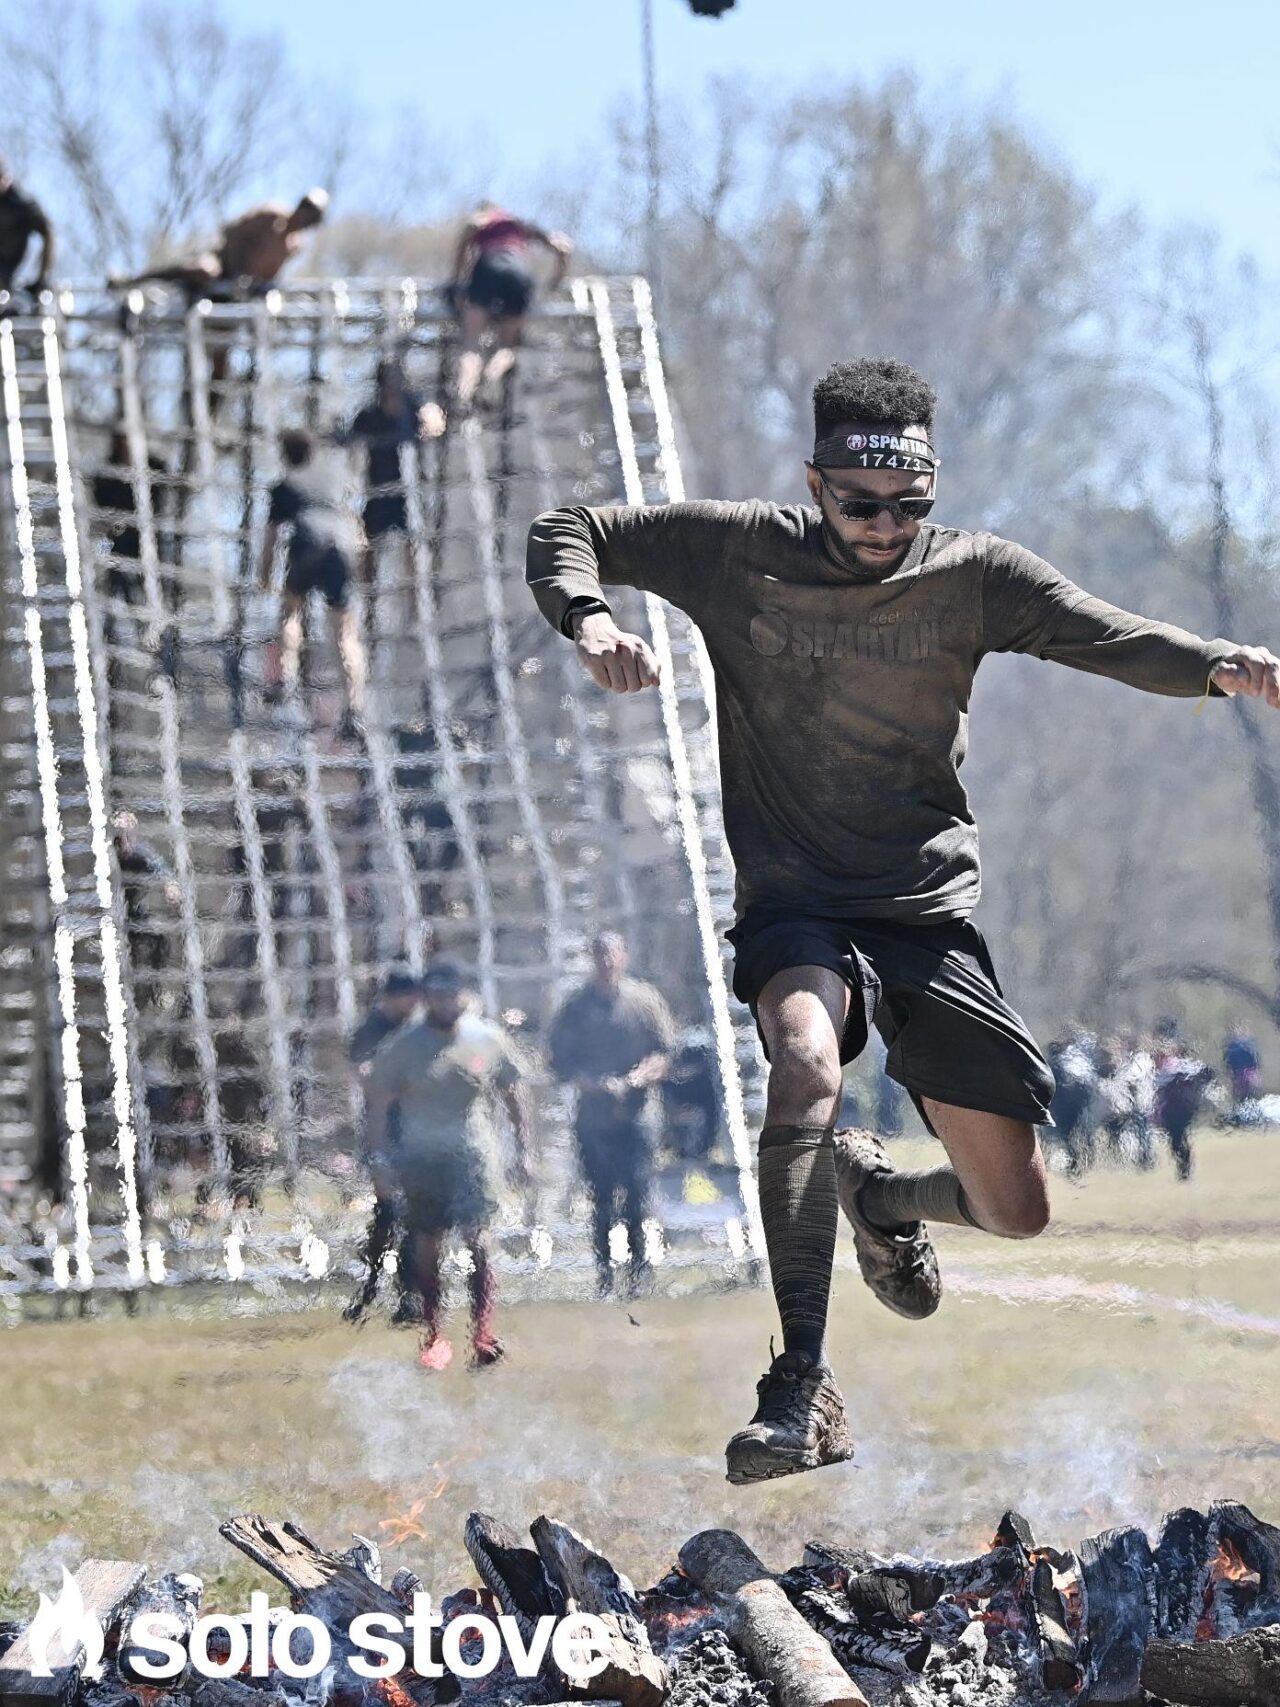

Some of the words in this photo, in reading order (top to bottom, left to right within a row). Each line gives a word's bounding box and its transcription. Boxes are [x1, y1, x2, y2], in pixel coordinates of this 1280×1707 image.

[868, 434, 928, 457] SPARTAN
[859, 453, 921, 471] 17473
[791, 620, 940, 662] SPARTAN
